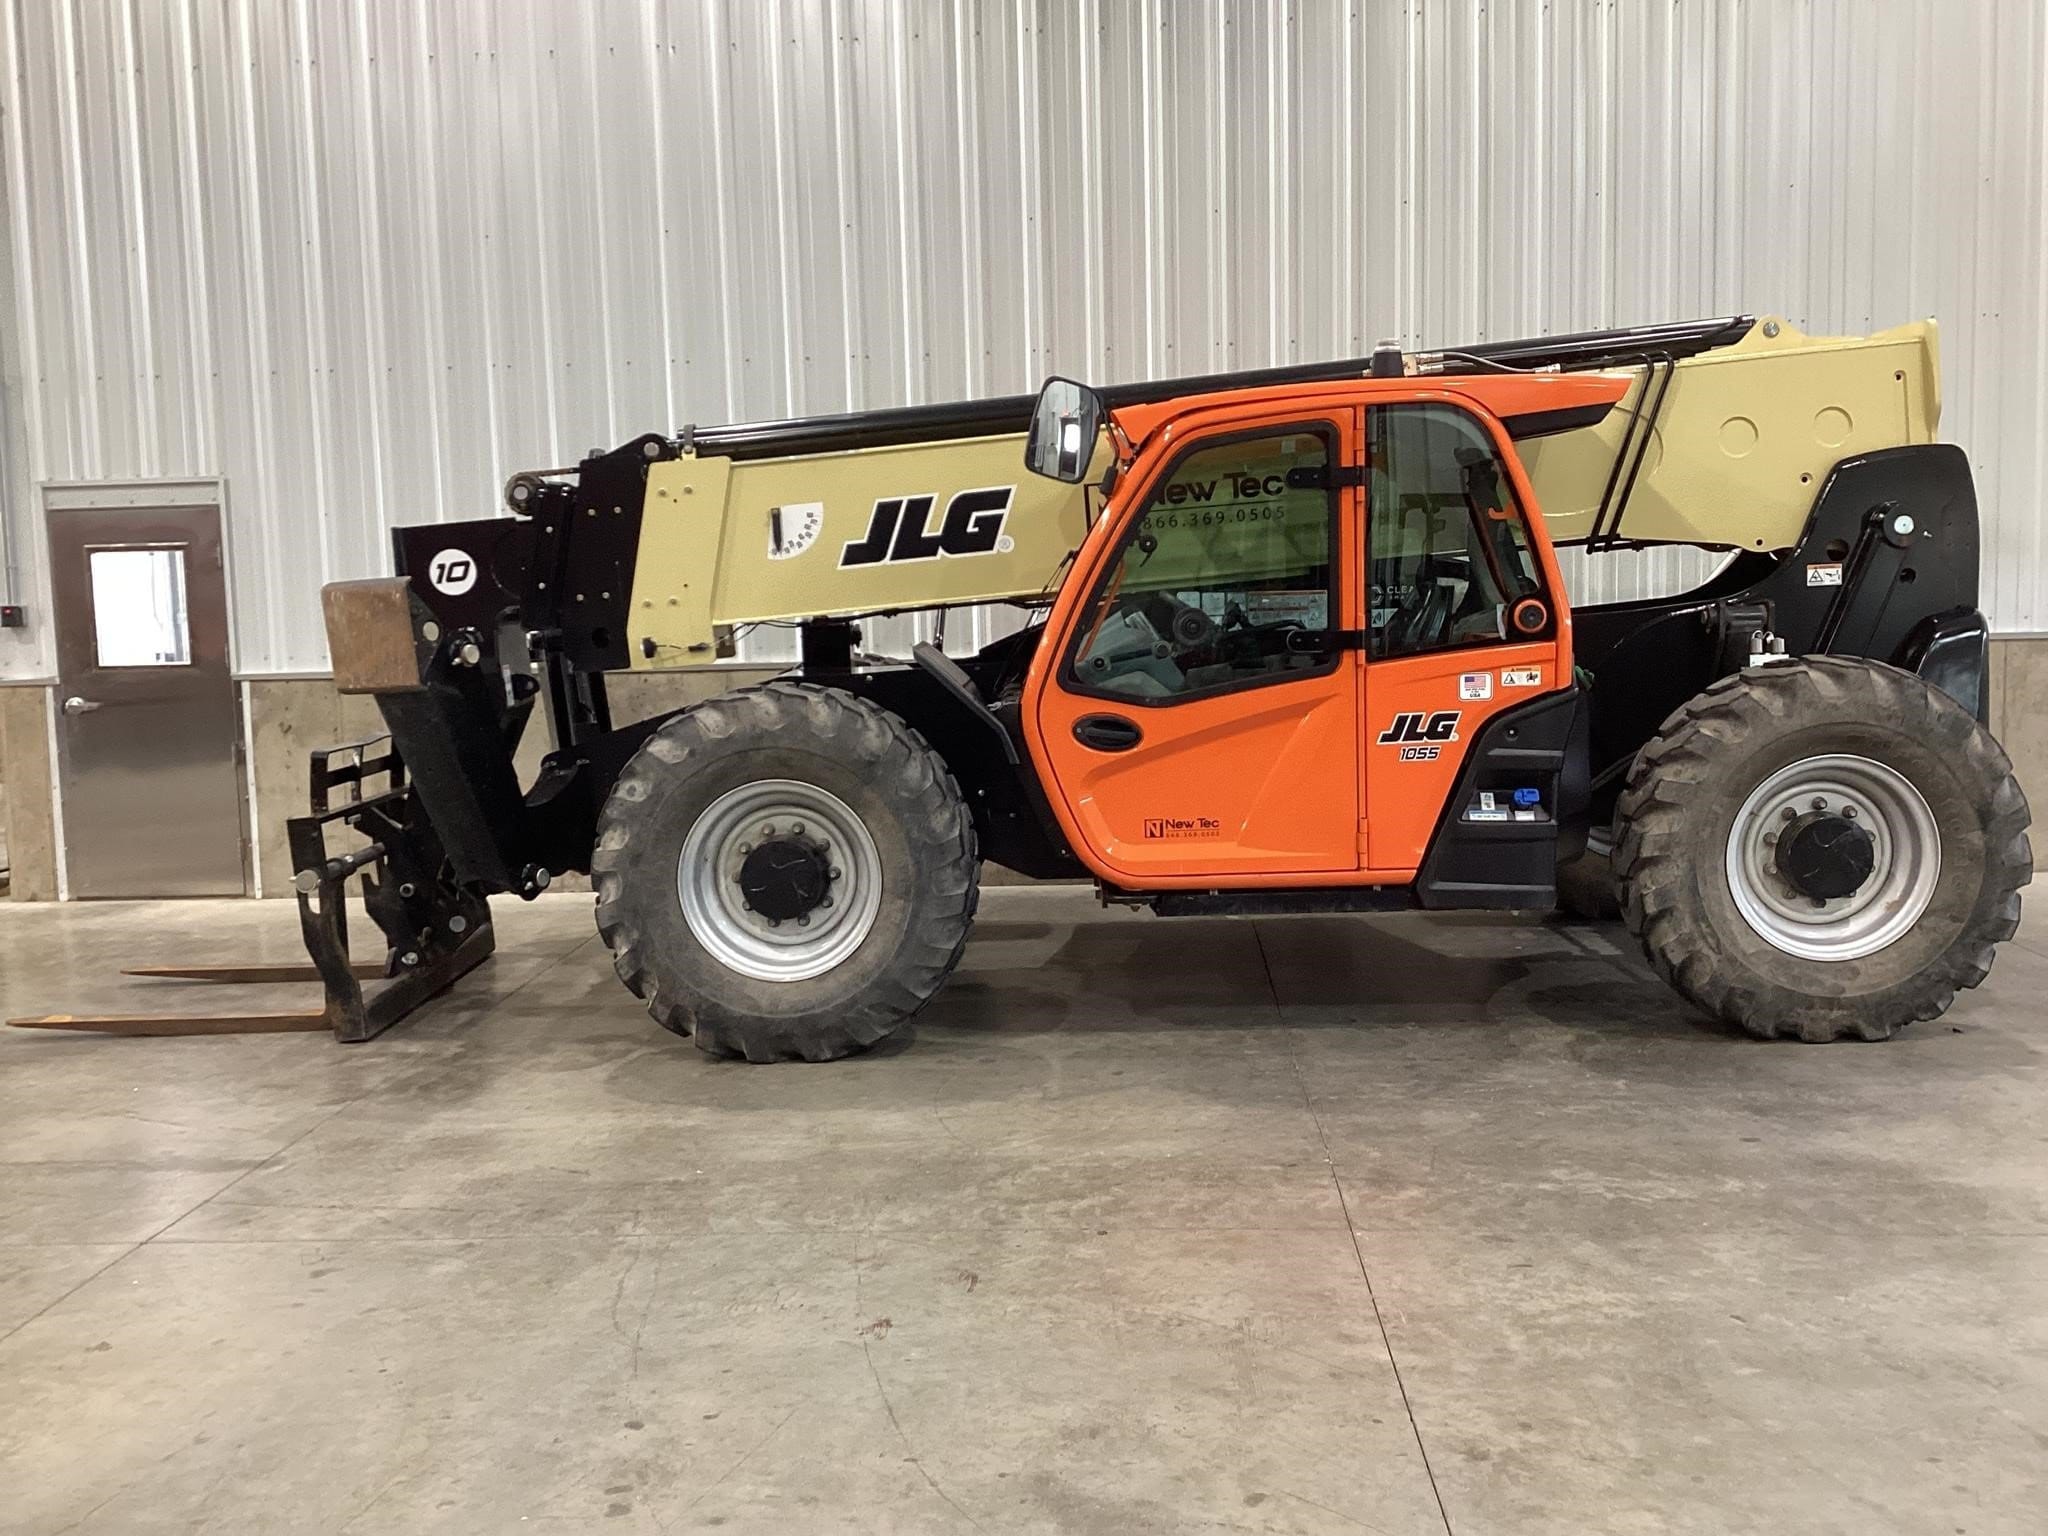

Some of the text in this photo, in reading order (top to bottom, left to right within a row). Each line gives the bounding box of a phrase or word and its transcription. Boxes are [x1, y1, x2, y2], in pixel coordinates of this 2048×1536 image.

[1222, 471, 1284, 499] Tec
[839, 485, 1014, 567] JLG
[434, 560, 471, 584] 10
[1378, 712, 1460, 743] JLG
[1400, 747, 1440, 761] 1055
[1165, 817, 1220, 829] New Tec
